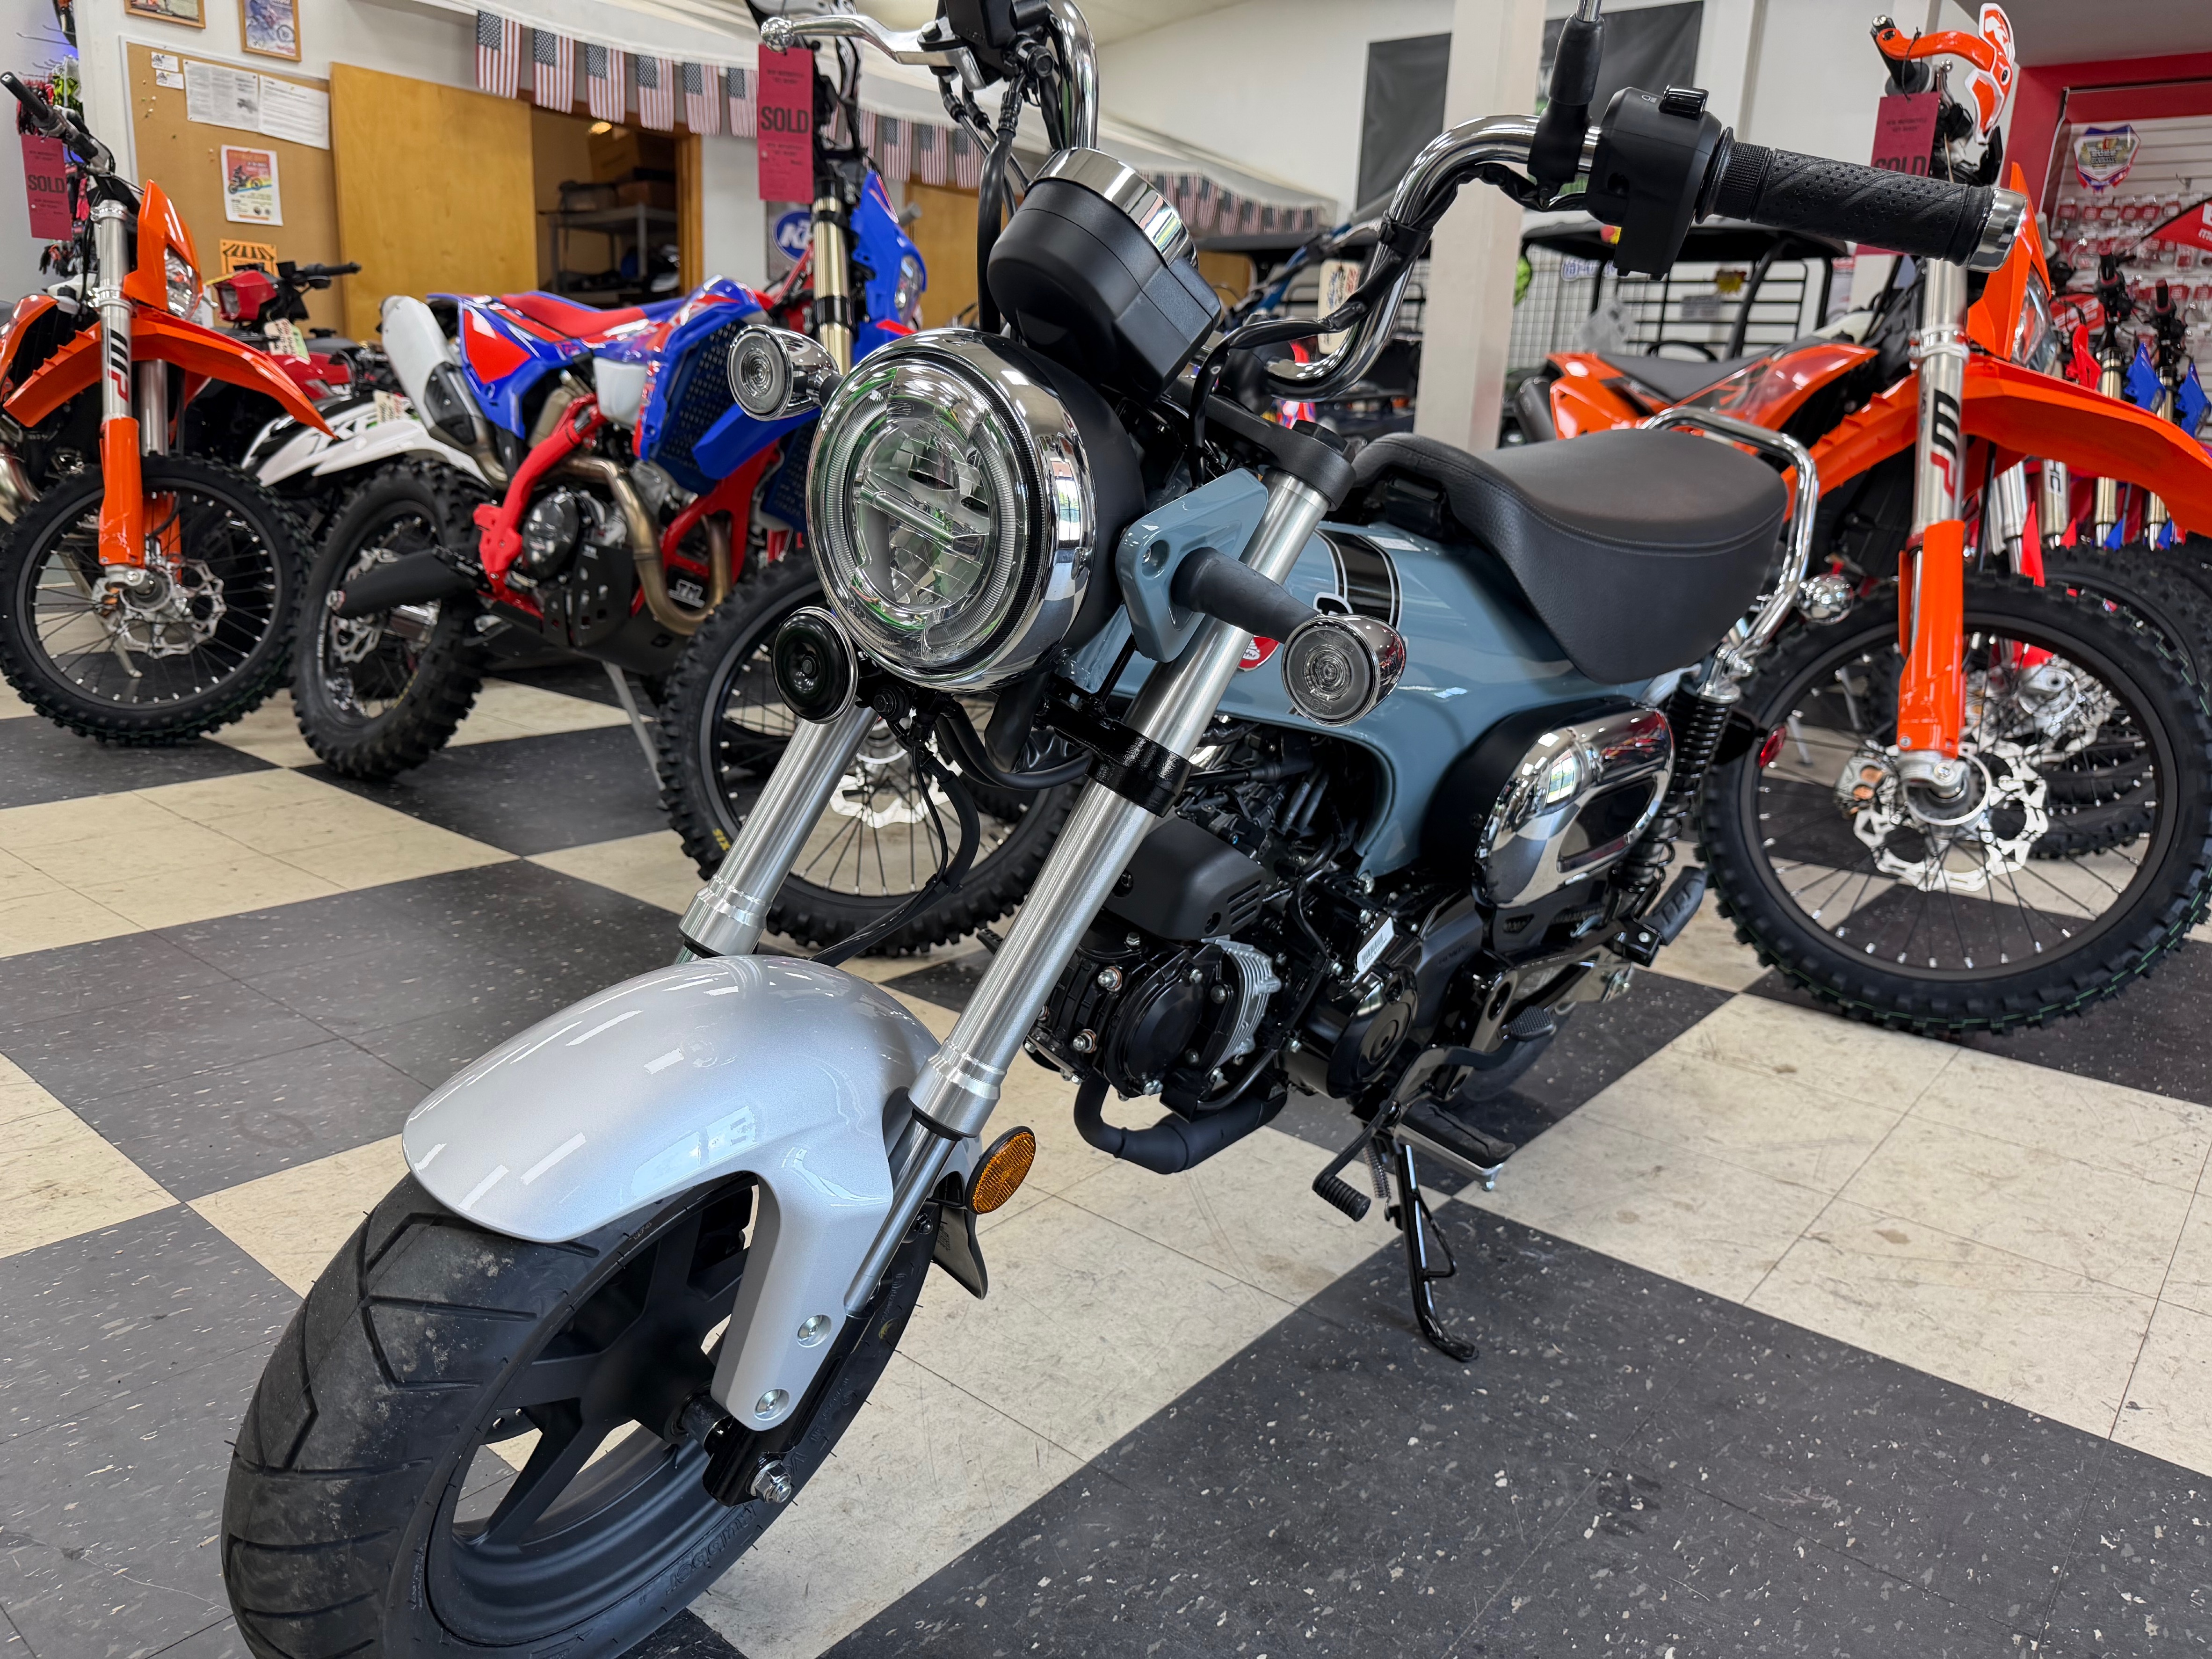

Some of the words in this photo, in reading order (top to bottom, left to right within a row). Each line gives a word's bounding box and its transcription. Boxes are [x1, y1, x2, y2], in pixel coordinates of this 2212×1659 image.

[761, 106, 809, 134] SOLD
[28, 174, 65, 194] SOLD
[666, 1503, 756, 1596] Rubber
